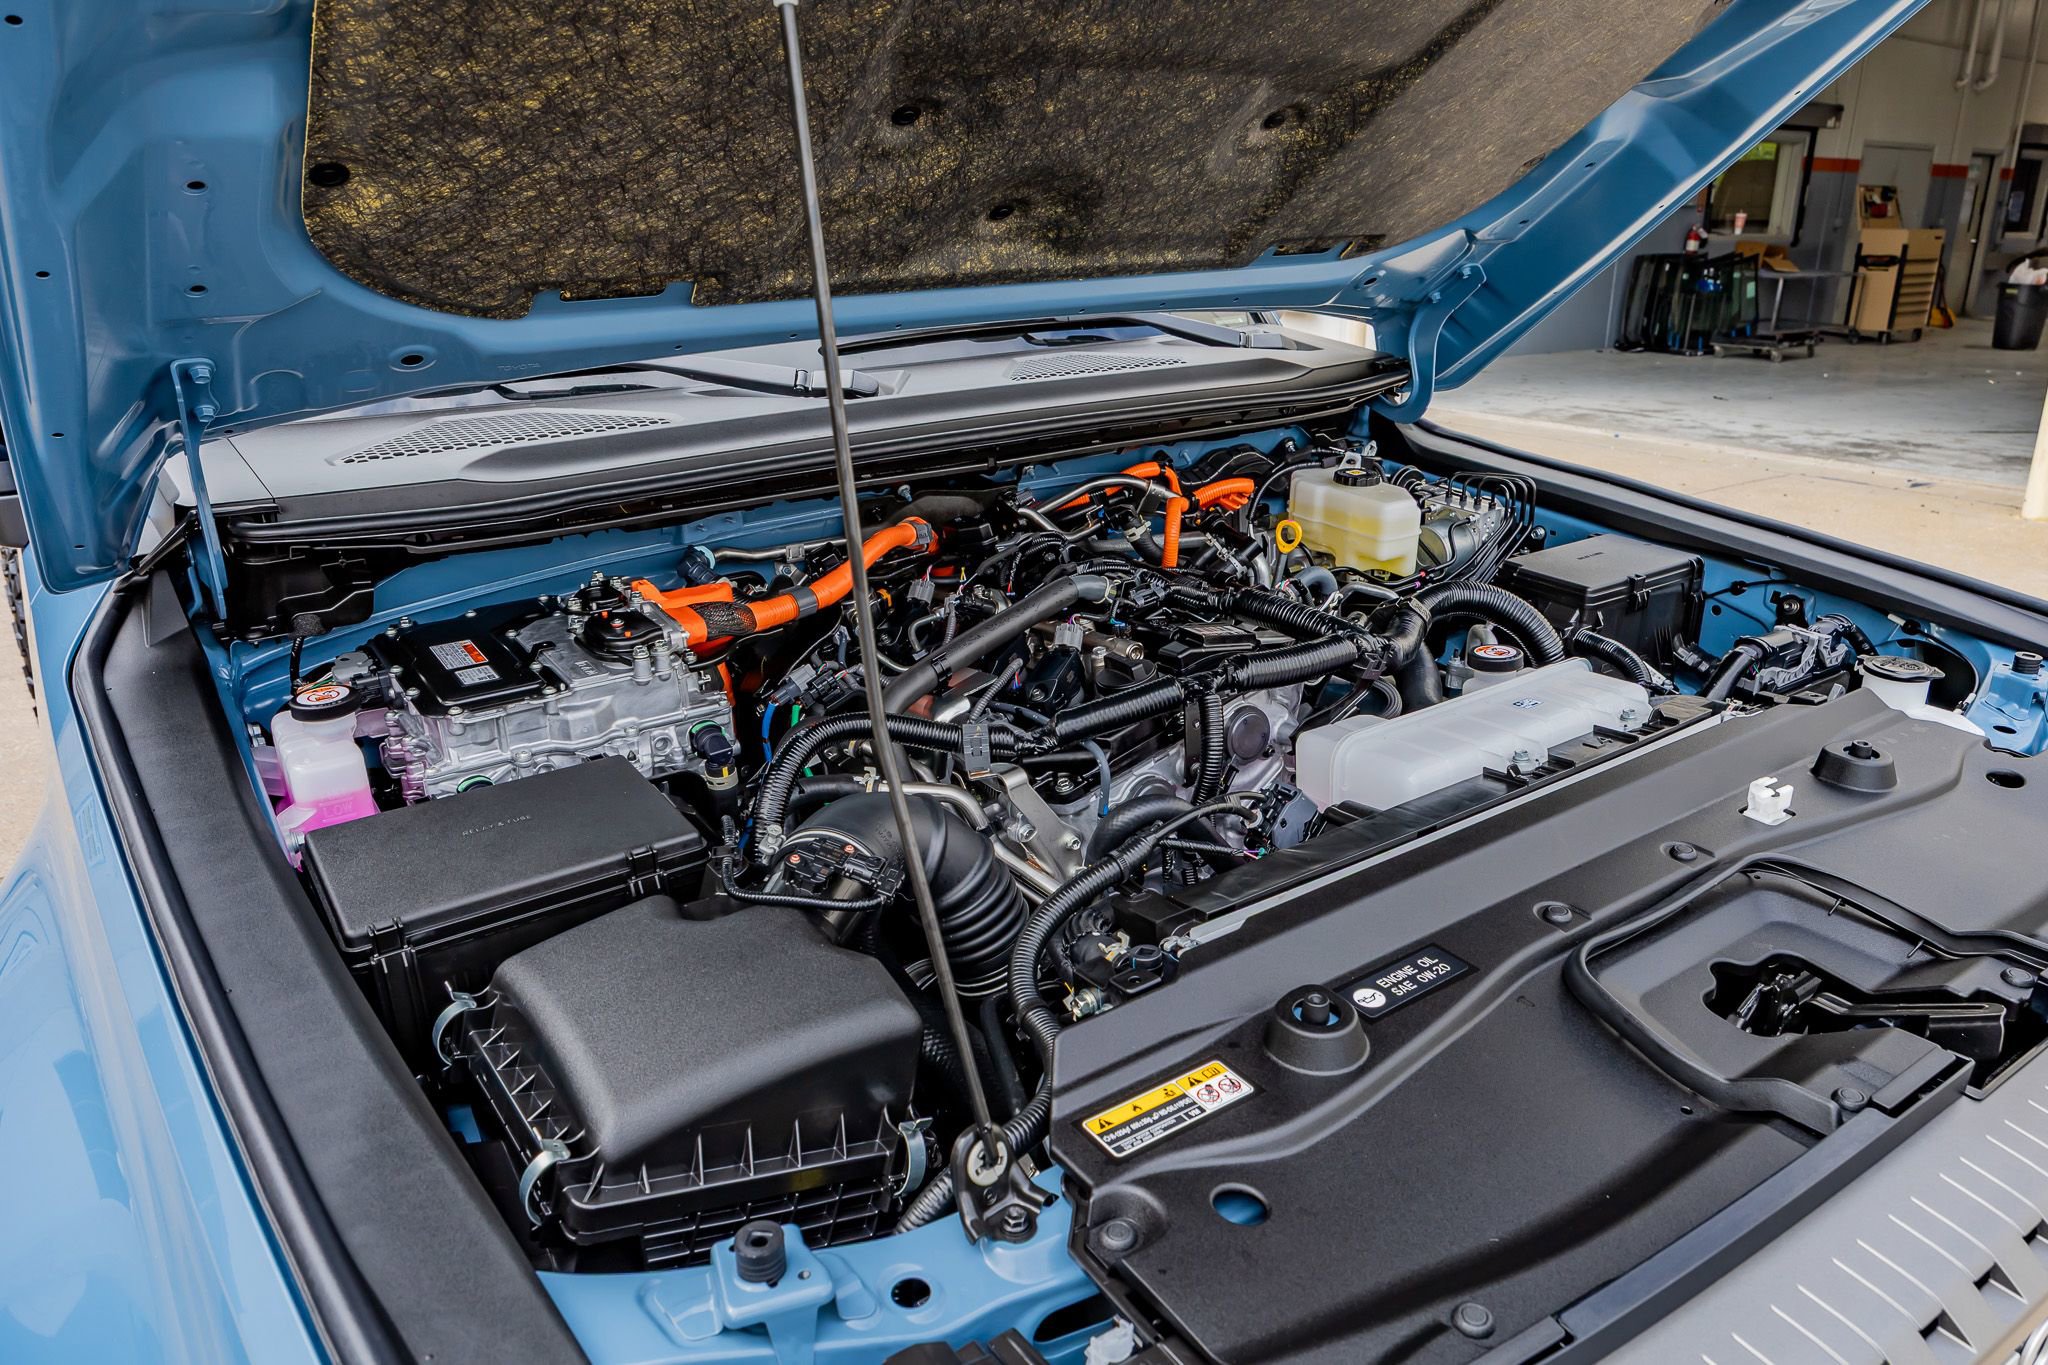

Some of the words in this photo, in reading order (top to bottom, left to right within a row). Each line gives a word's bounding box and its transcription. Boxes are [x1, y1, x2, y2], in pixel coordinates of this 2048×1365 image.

[322, 800, 353, 817] LOW
[1376, 965, 1418, 988] ENGINE
[1417, 956, 1439, 968] OIL
[1391, 980, 1418, 996] SAE
[1416, 963, 1451, 983] 0W-20
[1188, 1108, 1202, 1117] VM
